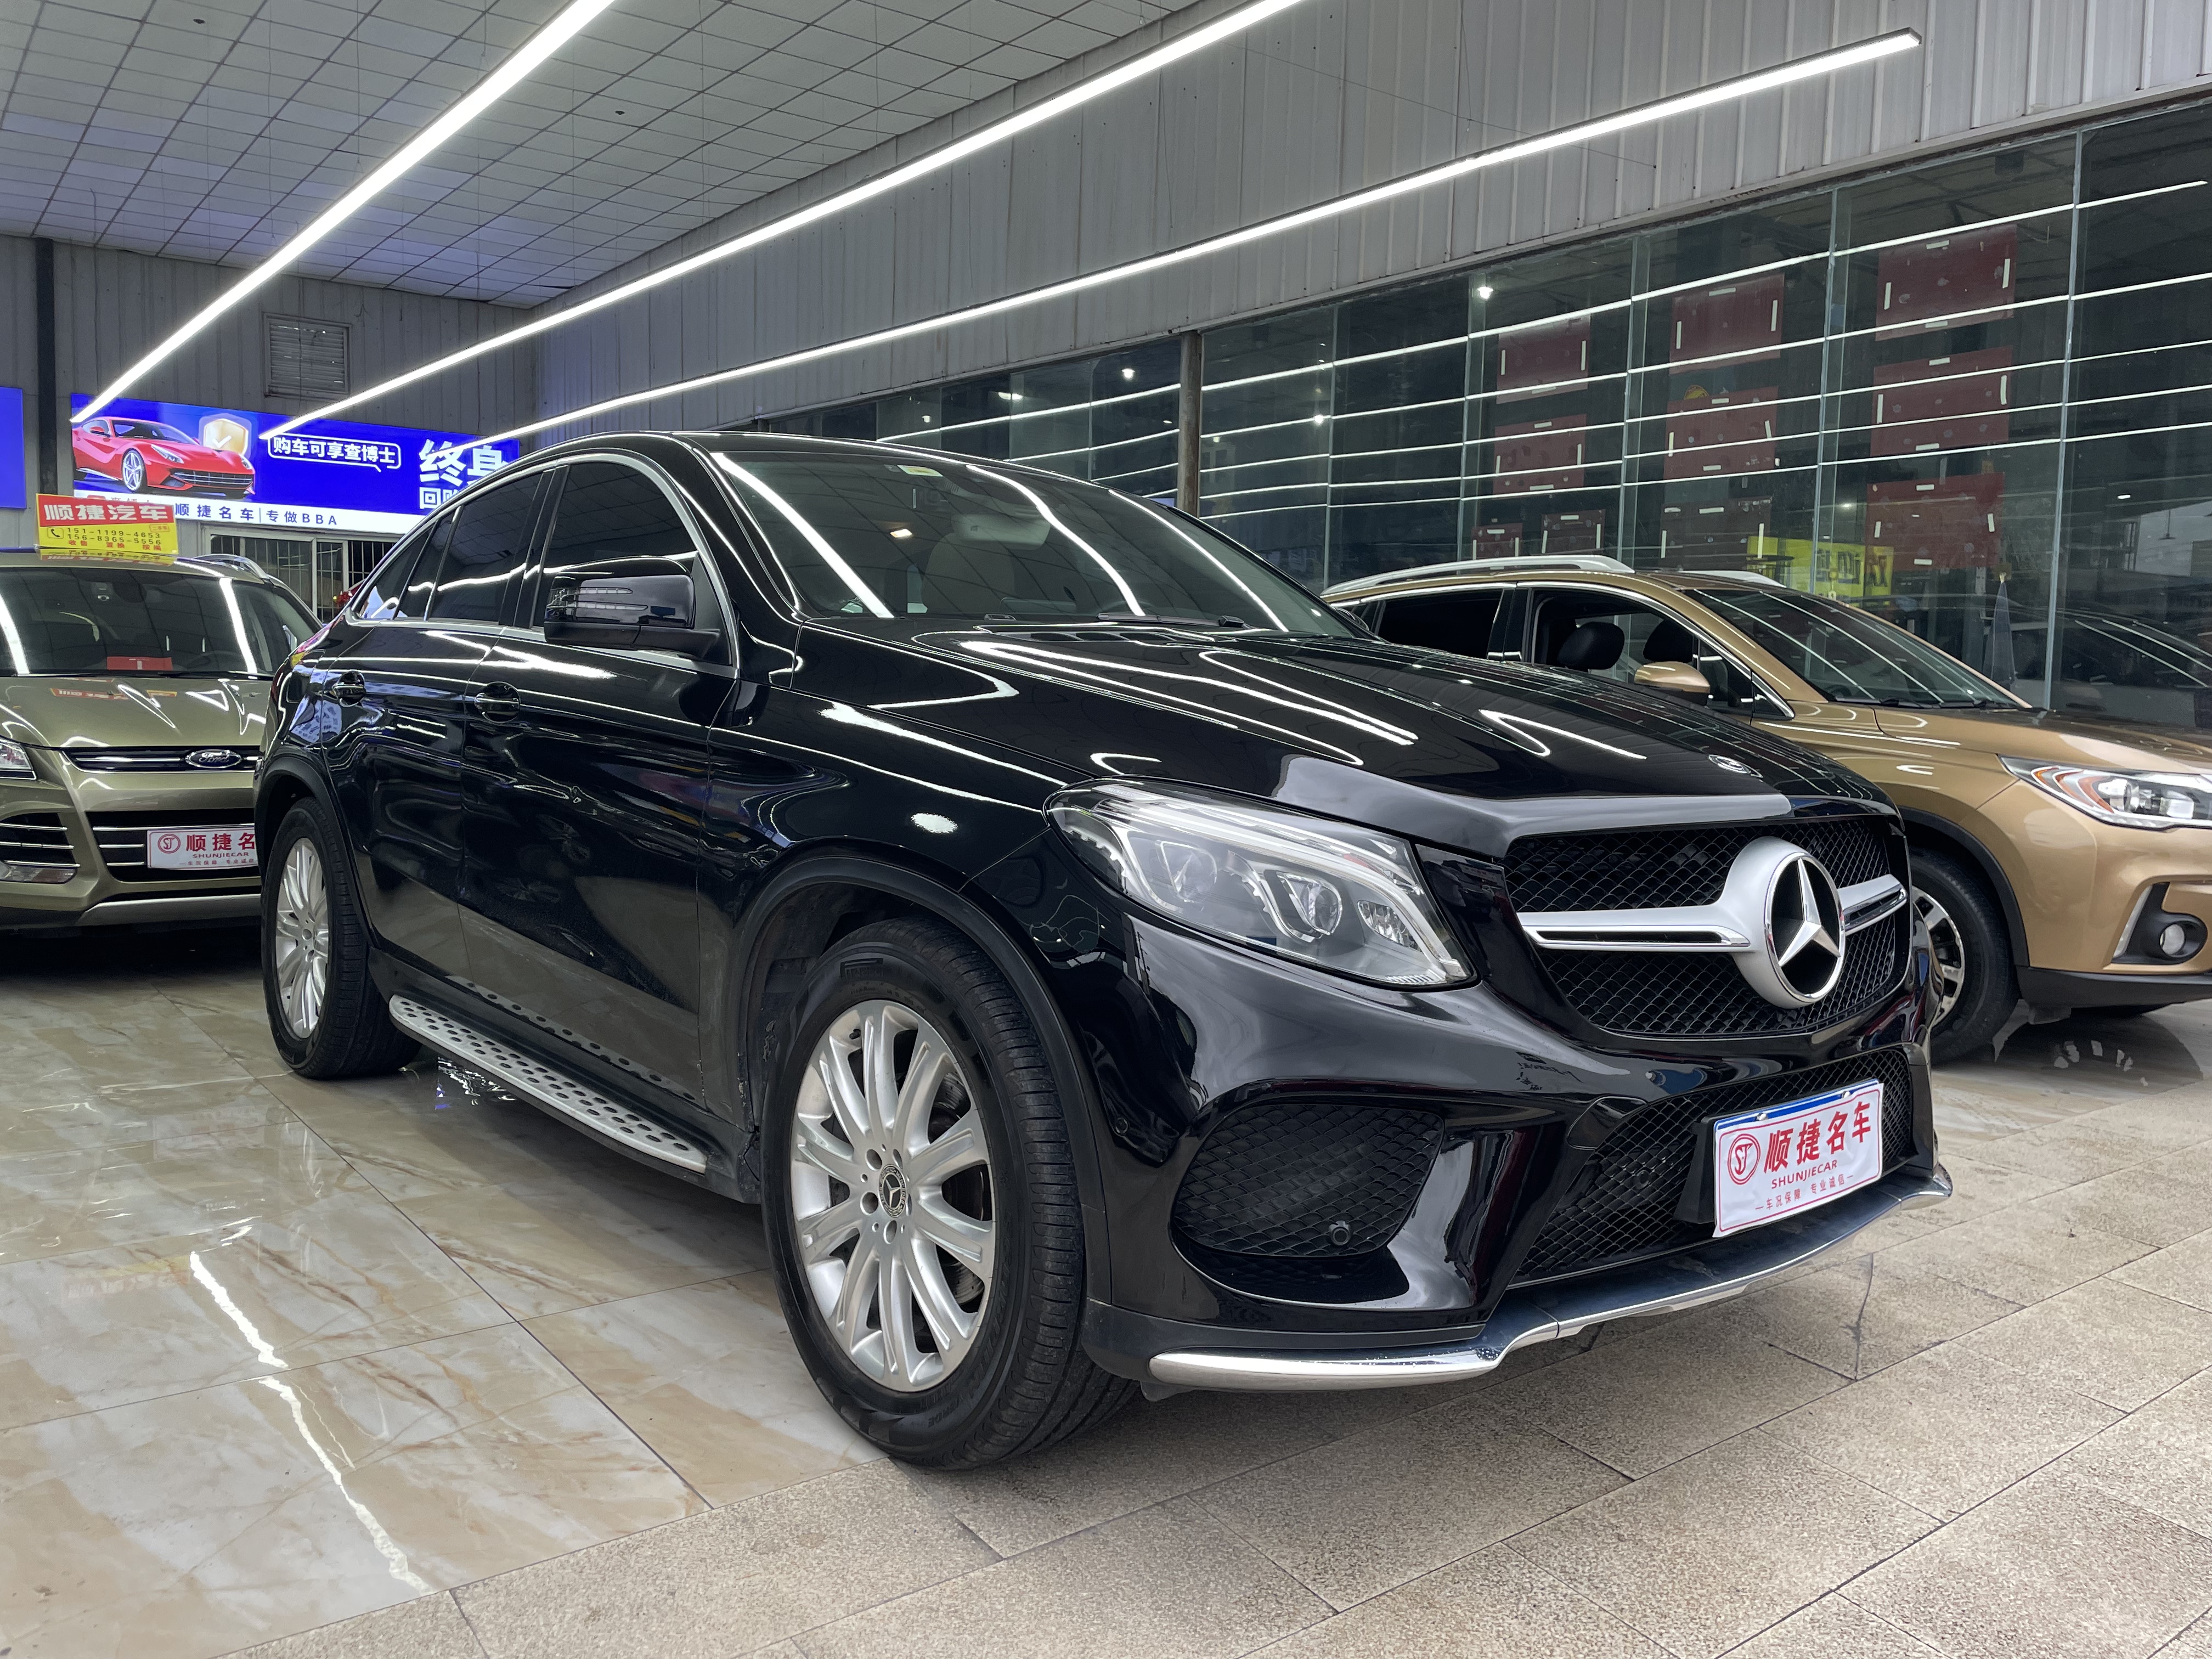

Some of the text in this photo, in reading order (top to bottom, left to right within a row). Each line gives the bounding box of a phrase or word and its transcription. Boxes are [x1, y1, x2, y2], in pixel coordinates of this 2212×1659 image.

[273, 437, 396, 464] 购车可享查博士
[419, 439, 509, 487] 终身
[44, 504, 168, 521] 顺捷汽车
[175, 503, 337, 525] 顺捷名车 专做BBA
[67, 527, 160, 539] 151-1199-4653
[67, 534, 161, 545] 156-8365-5556
[199, 752, 230, 763] Ford
[1764, 1101, 1871, 1173] 顺捷名车
[1771, 1160, 1837, 1189] SHUNJIECAR
